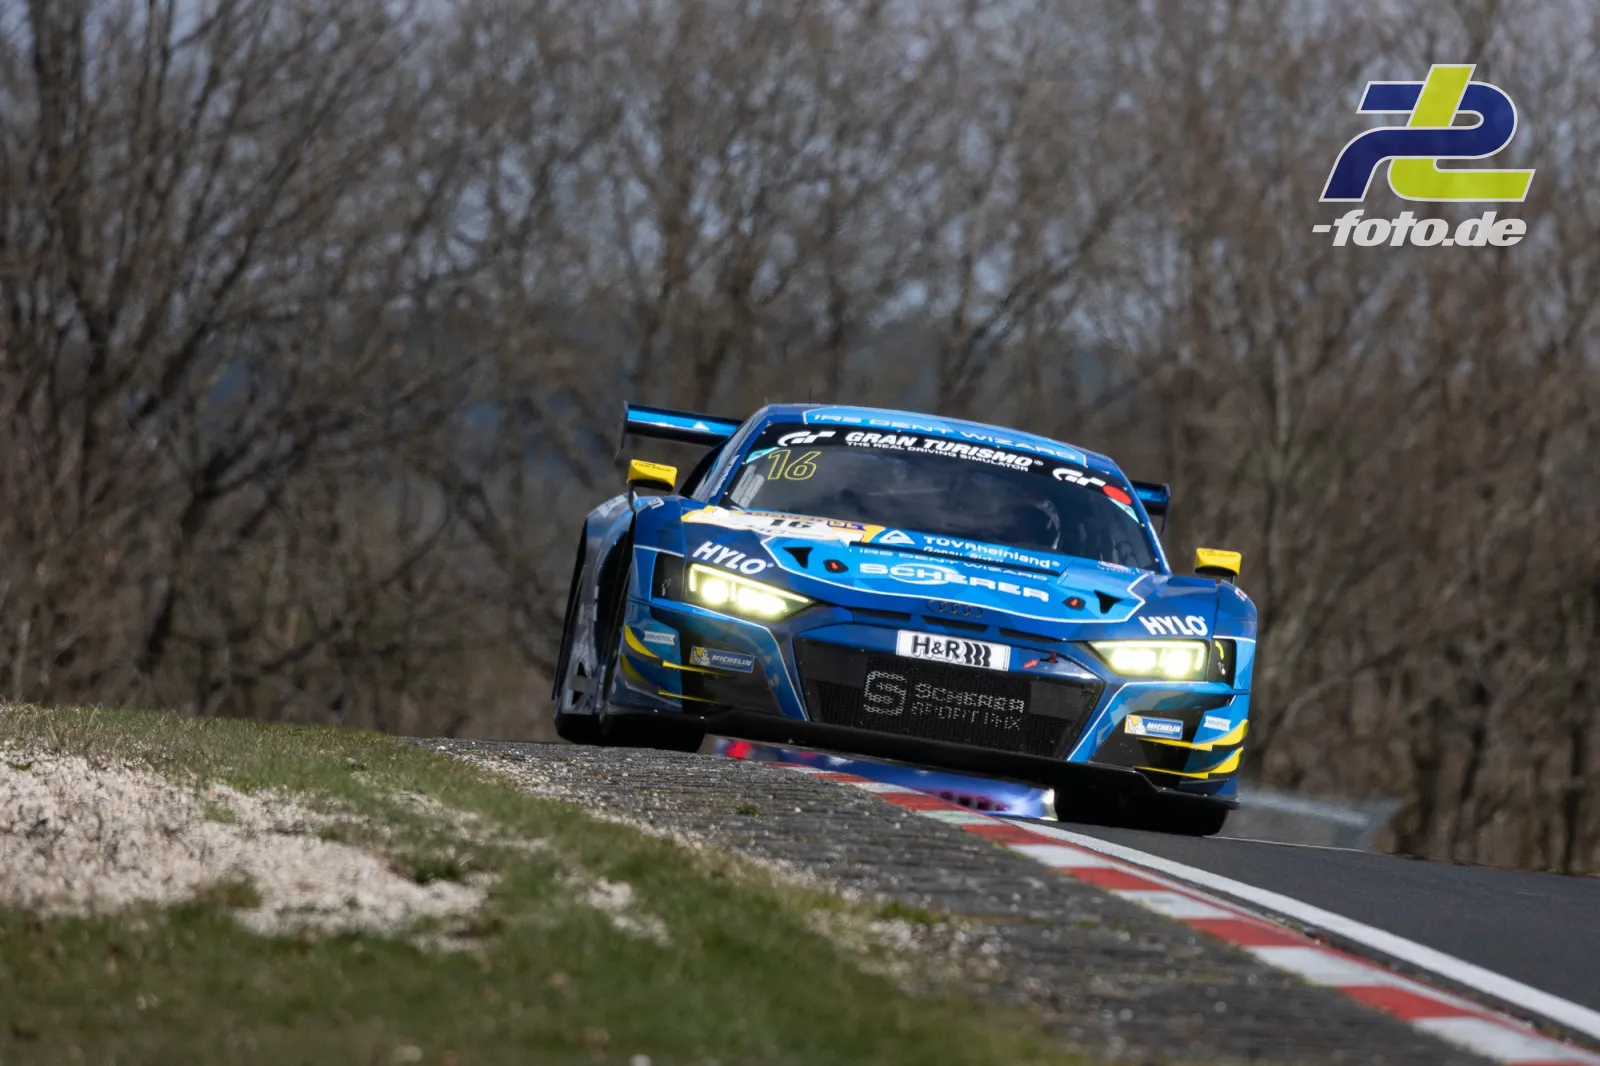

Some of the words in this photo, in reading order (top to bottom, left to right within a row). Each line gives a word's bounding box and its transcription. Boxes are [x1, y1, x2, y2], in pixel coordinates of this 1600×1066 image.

[845, 431, 918, 447] GRAN
[869, 418, 954, 434] DENT
[960, 430, 1077, 461] WIZARD
[767, 449, 822, 481] 16
[872, 443, 905, 451] REAL
[907, 446, 957, 458] DRIVING
[960, 451, 1029, 472] SIMULATOR
[859, 562, 1049, 603] SCHERER
[711, 654, 753, 667] MICHELIN
[911, 634, 961, 660] H&R
[1146, 721, 1181, 734] MICHELIN
